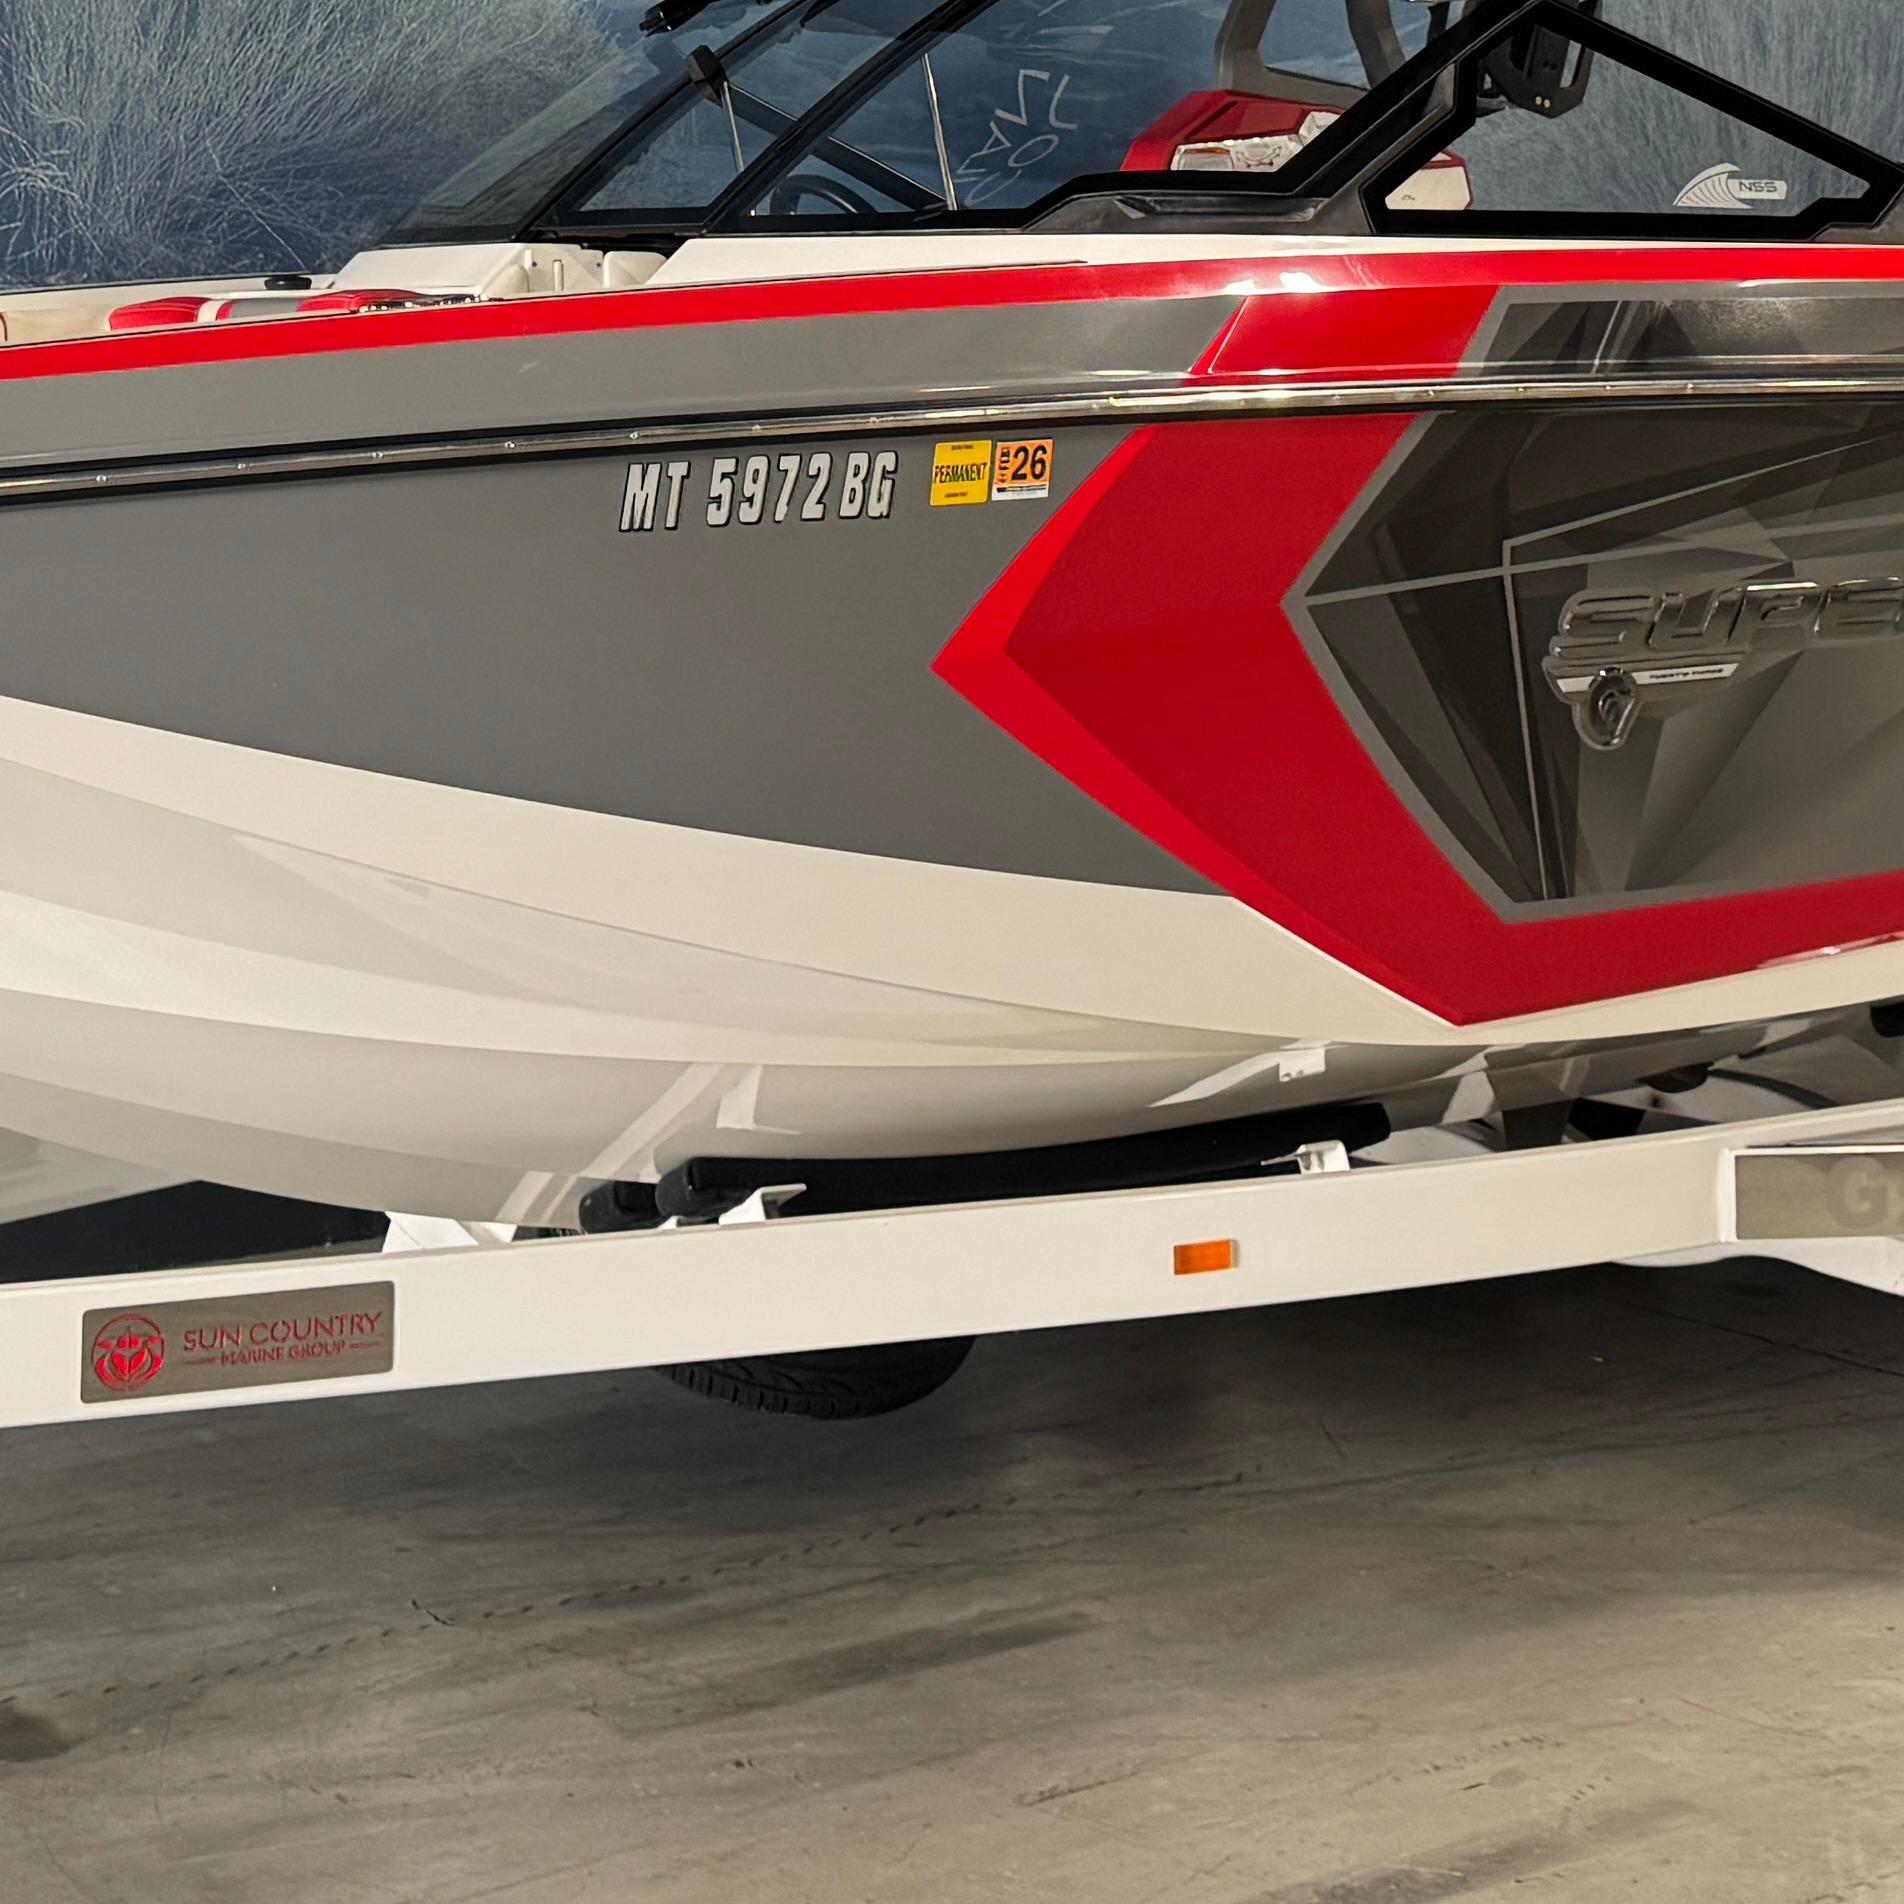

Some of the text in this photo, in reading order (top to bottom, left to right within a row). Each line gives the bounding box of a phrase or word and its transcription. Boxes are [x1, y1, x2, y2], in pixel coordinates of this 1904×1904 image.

[1738, 180, 1779, 194] NSS
[934, 461, 988, 484] PERMANENT
[1010, 443, 1048, 482] 26
[618, 460, 690, 533] MT
[183, 1311, 382, 1352] SUN COUNTRY
[220, 1340, 347, 1366] MARINE GROUP
